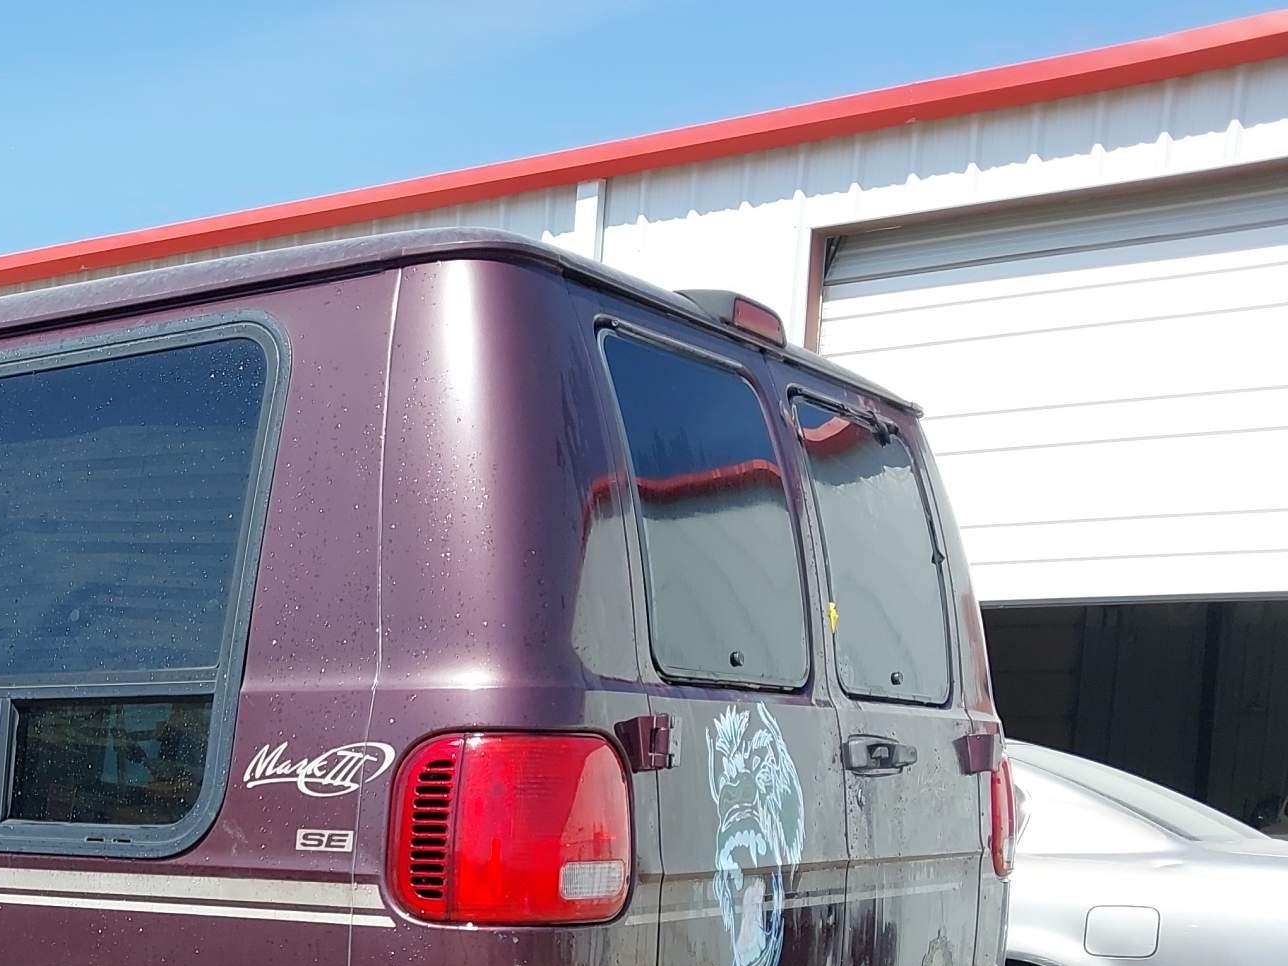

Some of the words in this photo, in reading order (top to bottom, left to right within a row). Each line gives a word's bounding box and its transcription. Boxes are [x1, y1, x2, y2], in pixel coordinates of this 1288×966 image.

[243, 741, 328, 783] Mark
[323, 750, 378, 787] III
[300, 832, 349, 849] SE
